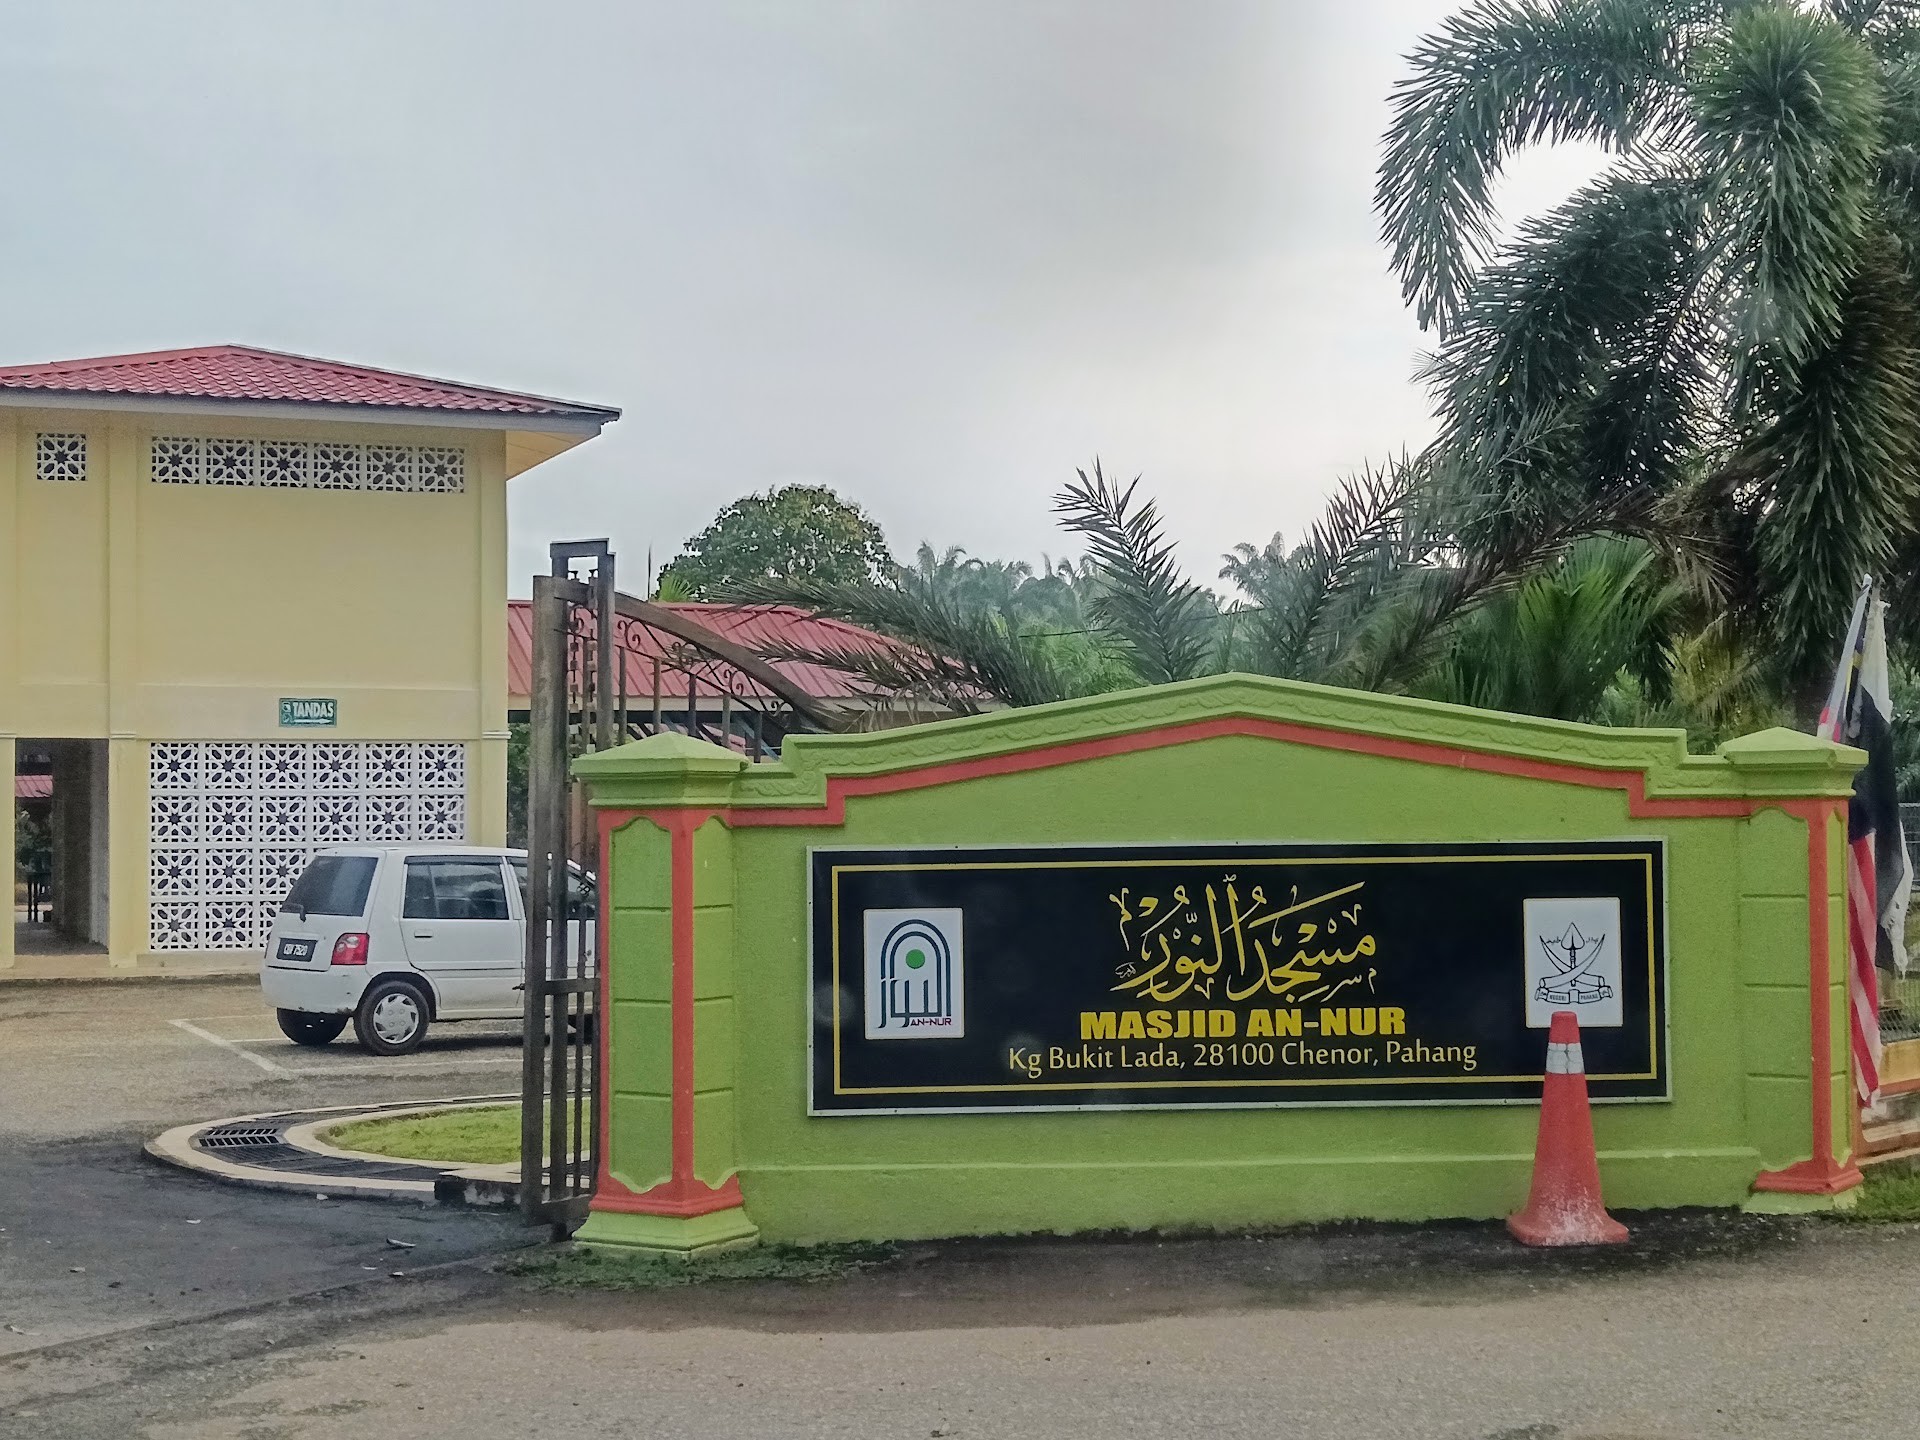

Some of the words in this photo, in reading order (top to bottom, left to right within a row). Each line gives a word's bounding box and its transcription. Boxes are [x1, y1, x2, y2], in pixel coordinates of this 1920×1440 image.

[292, 702, 334, 718] TANDAS
[910, 1017, 952, 1026] AN-NUR
[1080, 1009, 1236, 1040] MASJID
[1246, 1007, 1406, 1037] AN-NUR
[1009, 1047, 1042, 1079] Kg
[1049, 1043, 1114, 1069] Bukit
[1121, 1042, 1186, 1069] Lada,
[1193, 1043, 1274, 1067] 28100
[1281, 1040, 1379, 1067] Chenor,
[1386, 1038, 1478, 1072] Pahang
